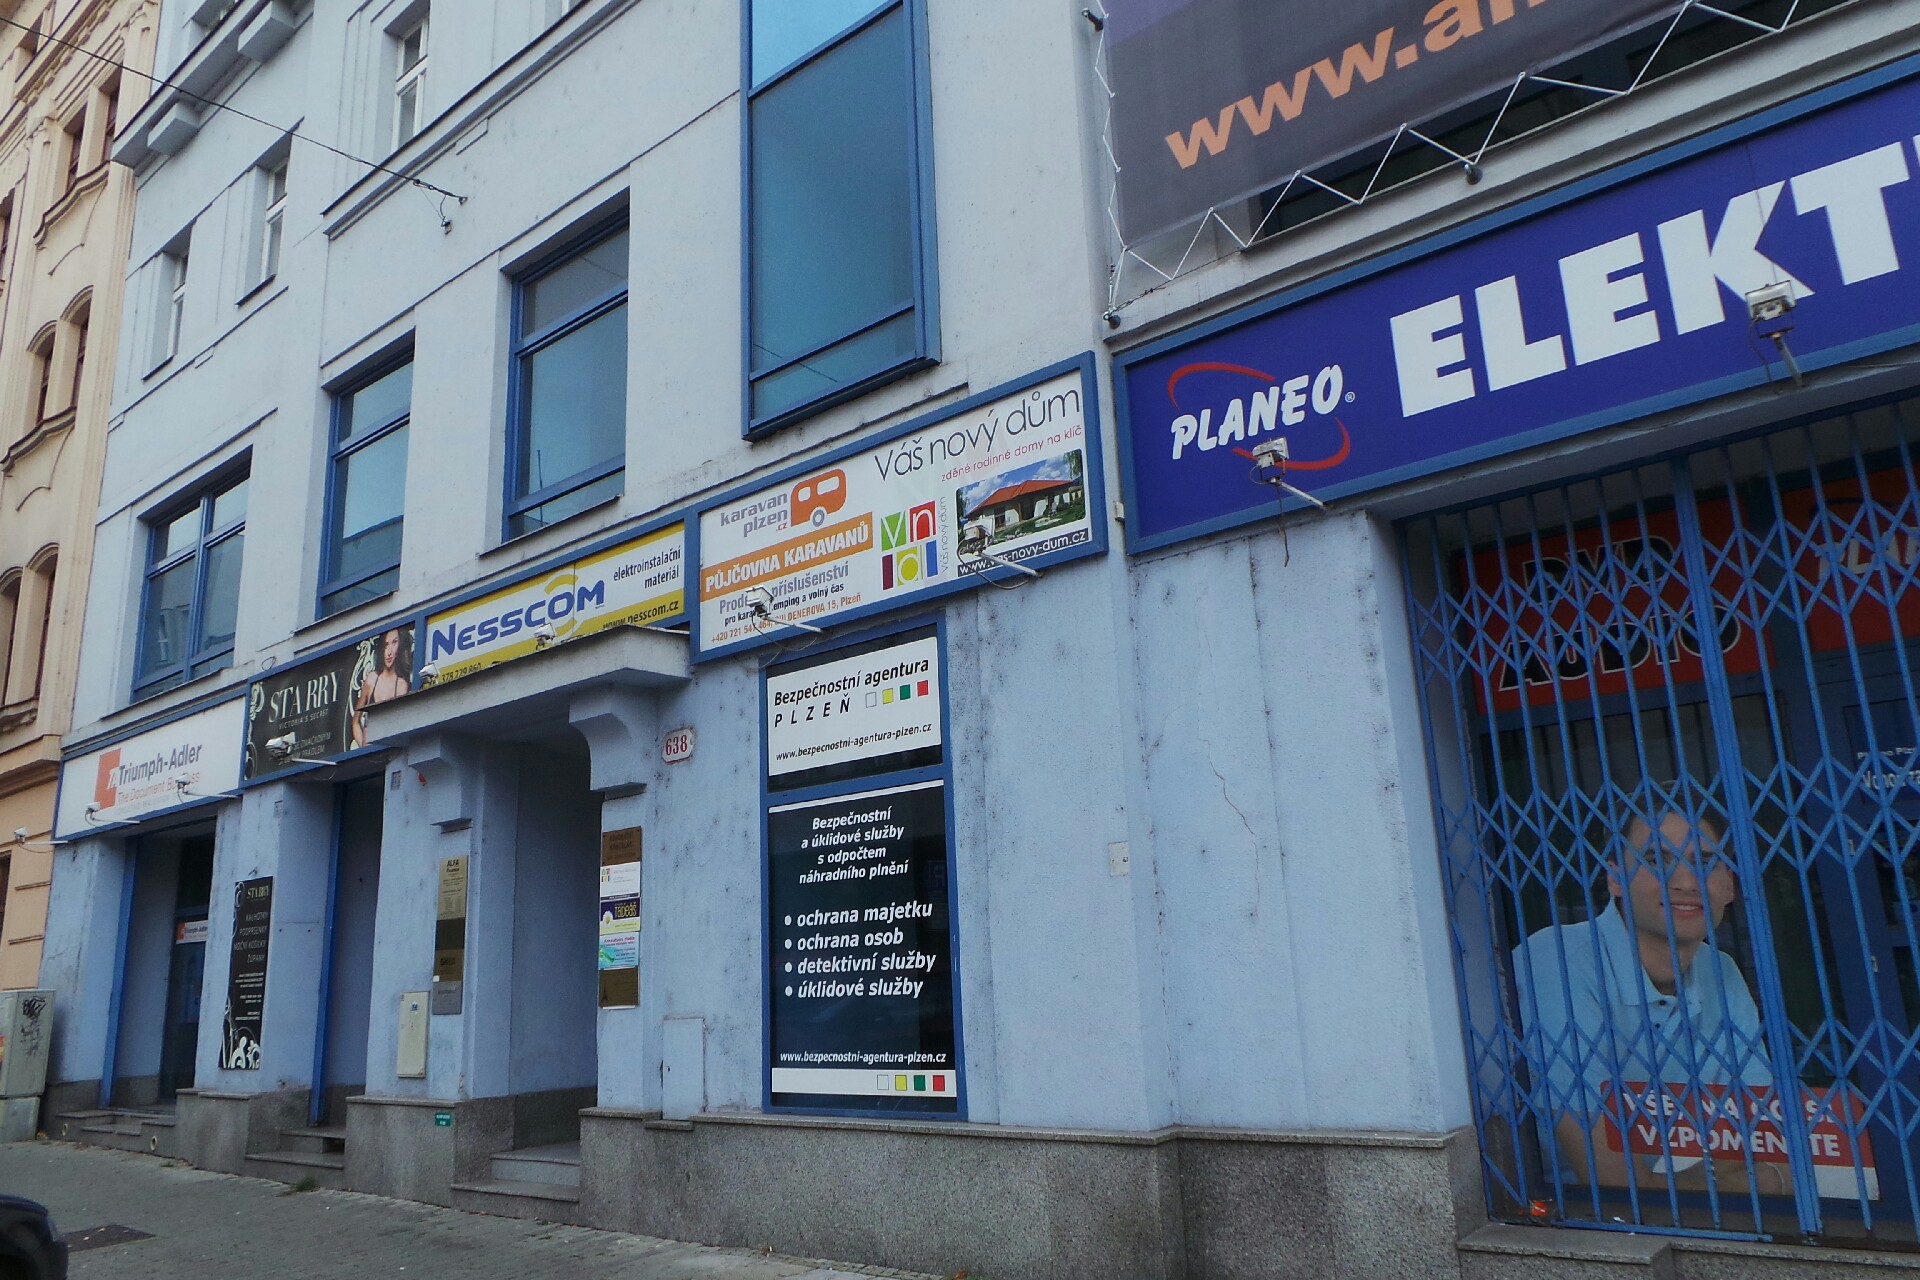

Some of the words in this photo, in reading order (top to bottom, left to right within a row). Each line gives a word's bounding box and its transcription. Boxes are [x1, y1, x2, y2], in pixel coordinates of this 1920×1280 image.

[1390, 134, 1920, 418] ELEKT
[1171, 364, 1344, 460] PLANEO
[875, 436, 924, 481] Váš
[930, 408, 999, 464] nový
[1005, 389, 1080, 436] dům
[941, 462, 971, 482] zděné
[973, 450, 1011, 470] rodinné
[1014, 439, 1044, 458] domy
[1047, 432, 1061, 446] na
[1064, 424, 1082, 439] klíč
[720, 493, 788, 527] karavan
[743, 508, 788, 538] plzen
[613, 545, 681, 582] elektroinstalační
[705, 554, 781, 593] PŮJČOVNA
[784, 520, 869, 572] KARAVANŮ
[1522, 534, 1675, 607] DVD
[644, 564, 680, 590] materiál
[771, 561, 849, 598] příslušenství
[431, 580, 605, 661] NESSCOM
[711, 630, 728, 643] +420
[730, 627, 741, 638] 721
[840, 593, 861, 608] Plzeň
[724, 615, 736, 627] pro
[771, 595, 800, 610] emping
[801, 594, 807, 603] a
[808, 584, 829, 601] volný
[831, 582, 845, 594] čas
[1499, 604, 1742, 692] AUDIO
[268, 669, 343, 723] STARRY
[774, 670, 862, 706] Bezpečnostní
[864, 659, 929, 687] agentura
[310, 708, 329, 721] SECRET
[665, 735, 688, 756] 638
[776, 722, 932, 761] www.bezpecnostni-agentura-plzen.cz
[119, 743, 203, 786] Triumph-Adler
[801, 838, 808, 849] a
[811, 829, 861, 847] úklidové
[864, 824, 905, 841] služby
[812, 806, 892, 830] Bezpečnostní
[799, 866, 866, 884] náhradního
[869, 859, 909, 880] plnění
[817, 854, 824, 865] s
[827, 845, 887, 865] odpočtem
[797, 908, 859, 927] ochrana
[864, 900, 933, 924] majetku
[797, 932, 859, 951] ochrana
[864, 927, 904, 946] osob
[797, 952, 878, 974] detektivní
[881, 950, 937, 973] služby
[798, 977, 864, 999] úklidové
[868, 976, 924, 999] služby
[780, 1050, 947, 1066] www.bezpecnostni-agentura-plzen.cz
[1637, 1124, 1841, 1158] VZPOMENTE
